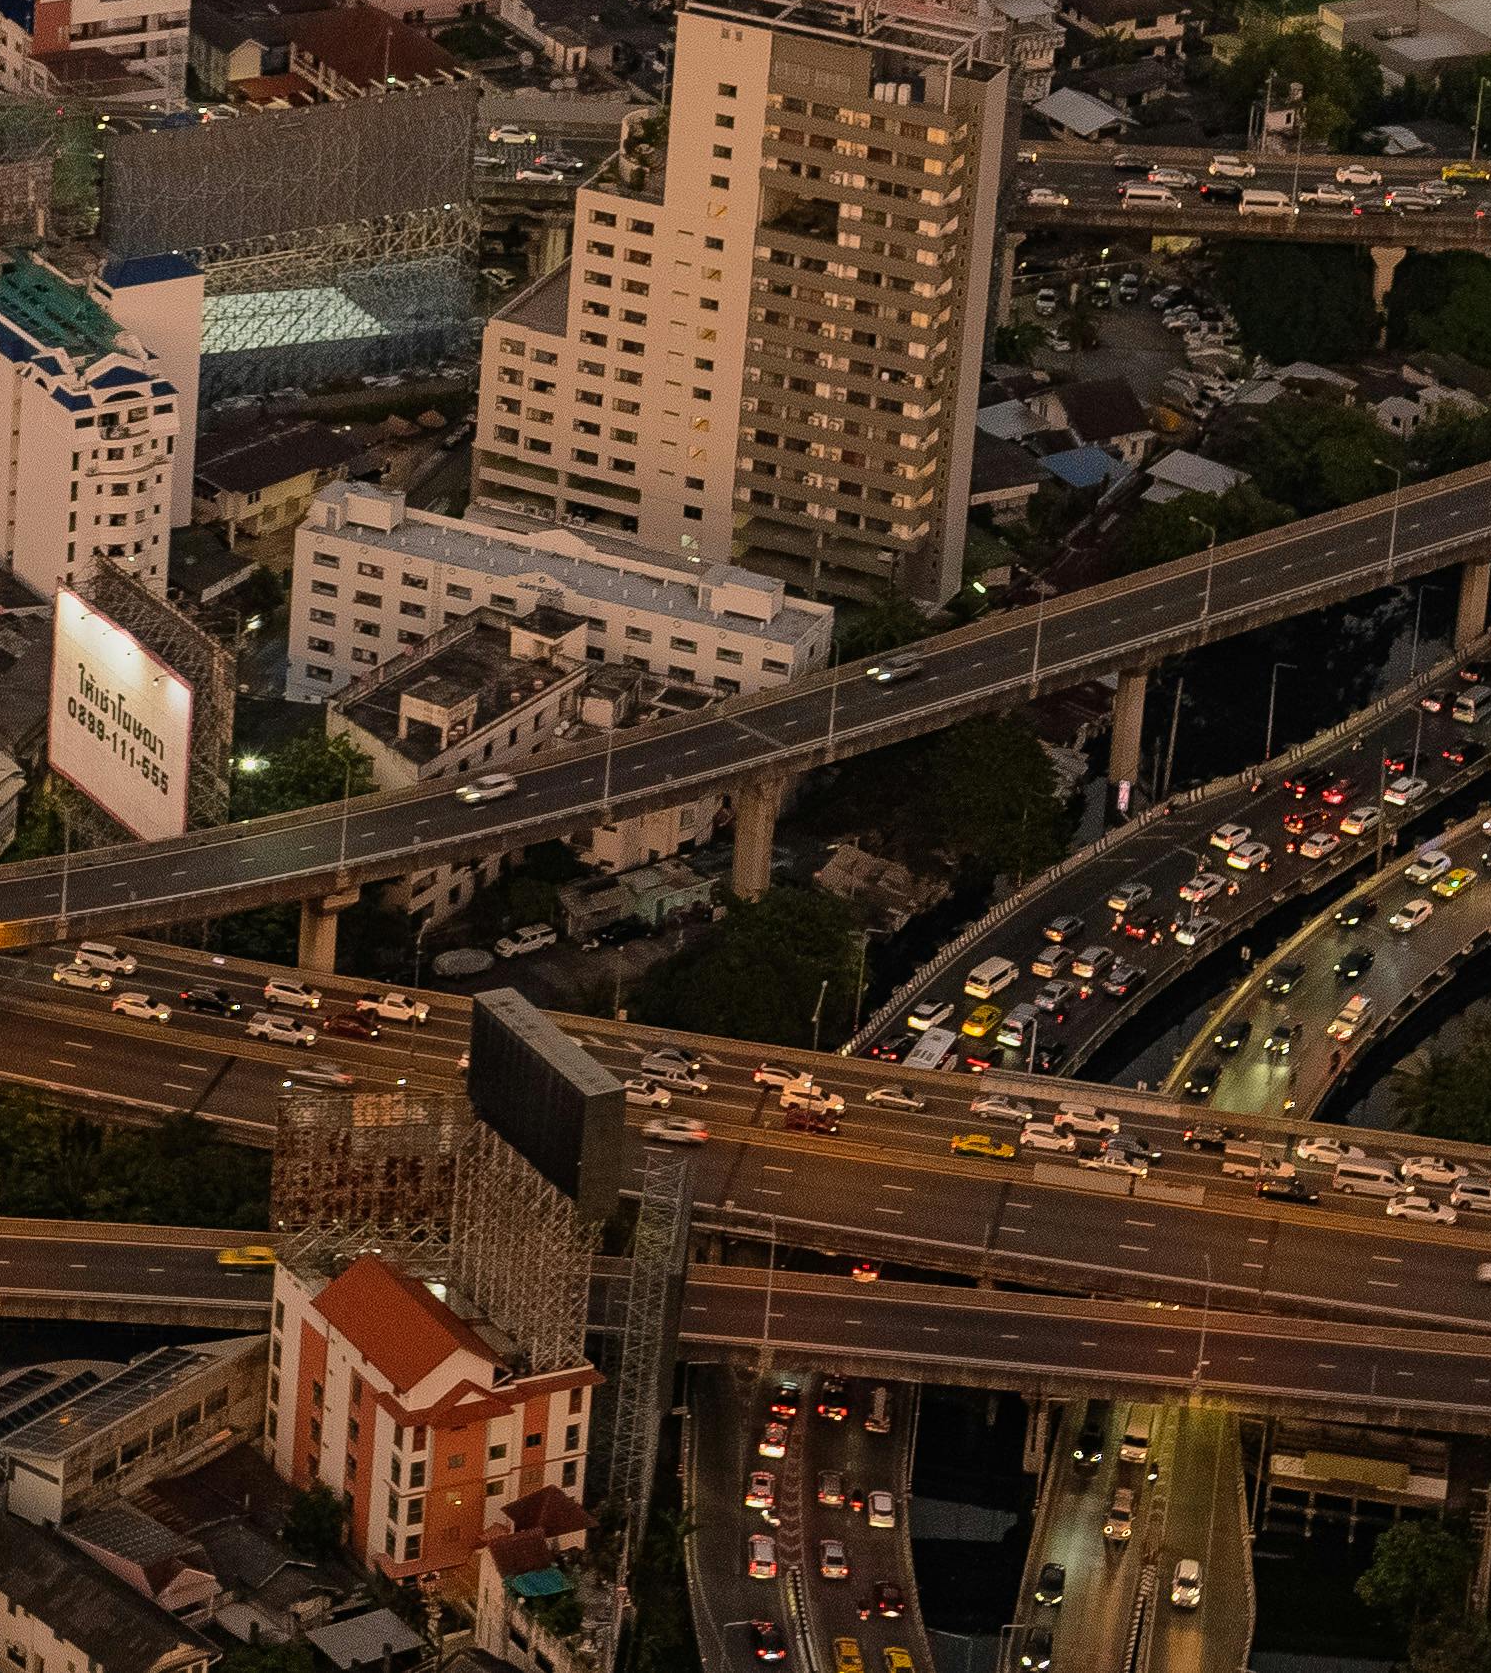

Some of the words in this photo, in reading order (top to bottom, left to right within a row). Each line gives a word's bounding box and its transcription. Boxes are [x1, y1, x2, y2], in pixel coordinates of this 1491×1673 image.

[78, 663, 164, 760] ให้เช่าโฆษณา
